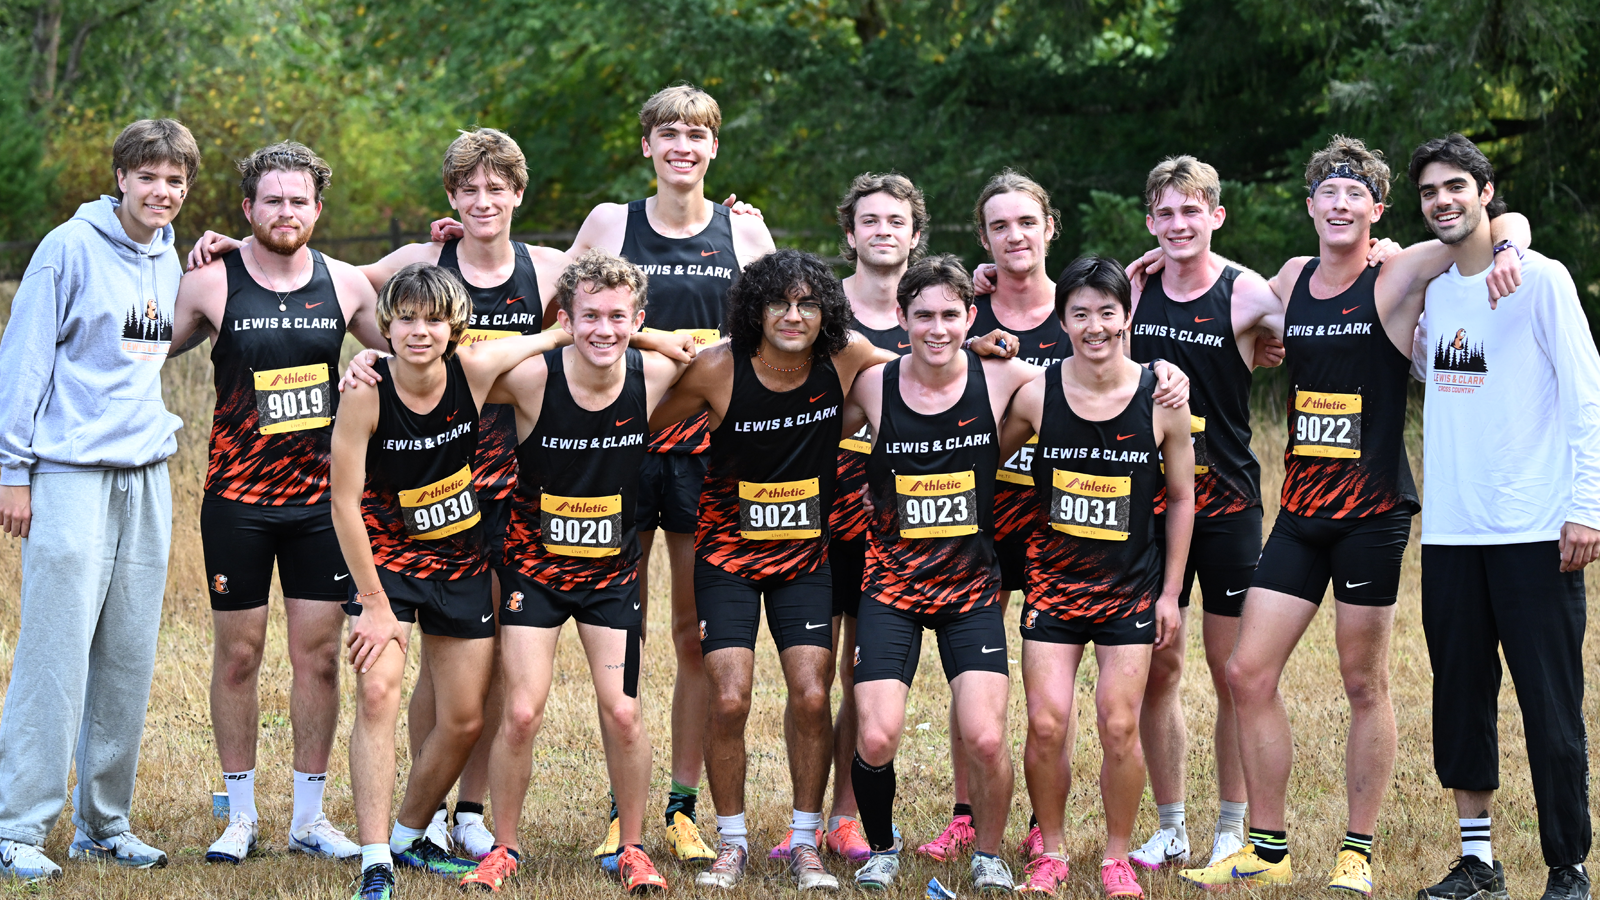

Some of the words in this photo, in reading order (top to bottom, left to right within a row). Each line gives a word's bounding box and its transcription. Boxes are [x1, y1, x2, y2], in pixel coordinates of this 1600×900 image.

[636, 264, 671, 275] WIS
[674, 264, 684, 275] &
[687, 264, 732, 279] CLARK
[234, 317, 279, 331] LEWIS
[281, 317, 292, 329] &
[294, 317, 338, 330] CLARK
[480, 314, 490, 326] &
[492, 312, 536, 326] CLARK
[1134, 323, 1168, 337] LEWIS
[1177, 329, 1225, 348] CLARK
[1315, 324, 1326, 336] &
[1327, 322, 1373, 336] CLARK
[270, 371, 317, 387] Athletic
[1433, 373, 1451, 383] LEWIS
[1452, 374, 1457, 384] &
[1458, 375, 1485, 385] CLARK
[1438, 385, 1451, 393] CROSS
[1451, 386, 1475, 394] COUNTRY
[267, 387, 323, 420] 9019
[1301, 396, 1347, 411] Athletic
[734, 418, 781, 433] LEWIS
[783, 417, 794, 428] &
[796, 404, 839, 426] CLARK
[1296, 415, 1352, 444] 9022
[424, 437, 435, 449] &
[541, 436, 588, 450] LEWIS
[590, 437, 601, 449] &
[602, 432, 644, 449] CLARK
[886, 441, 929, 454] LEWIS
[932, 439, 943, 452] &
[945, 432, 992, 450] CLARK
[1043, 446, 1088, 459] LEWIS
[1090, 447, 1101, 459] &
[1102, 449, 1150, 464] CLARK
[416, 479, 464, 504] Athletic
[753, 487, 806, 499] Athletic
[909, 479, 962, 492] Athletic
[1065, 477, 1117, 494] Athletic
[414, 490, 474, 531] 9030
[555, 501, 608, 514] Athletic
[749, 502, 811, 528] 9021
[905, 495, 968, 525] 9023
[1060, 495, 1118, 527] 9031
[550, 517, 613, 545] 9020
